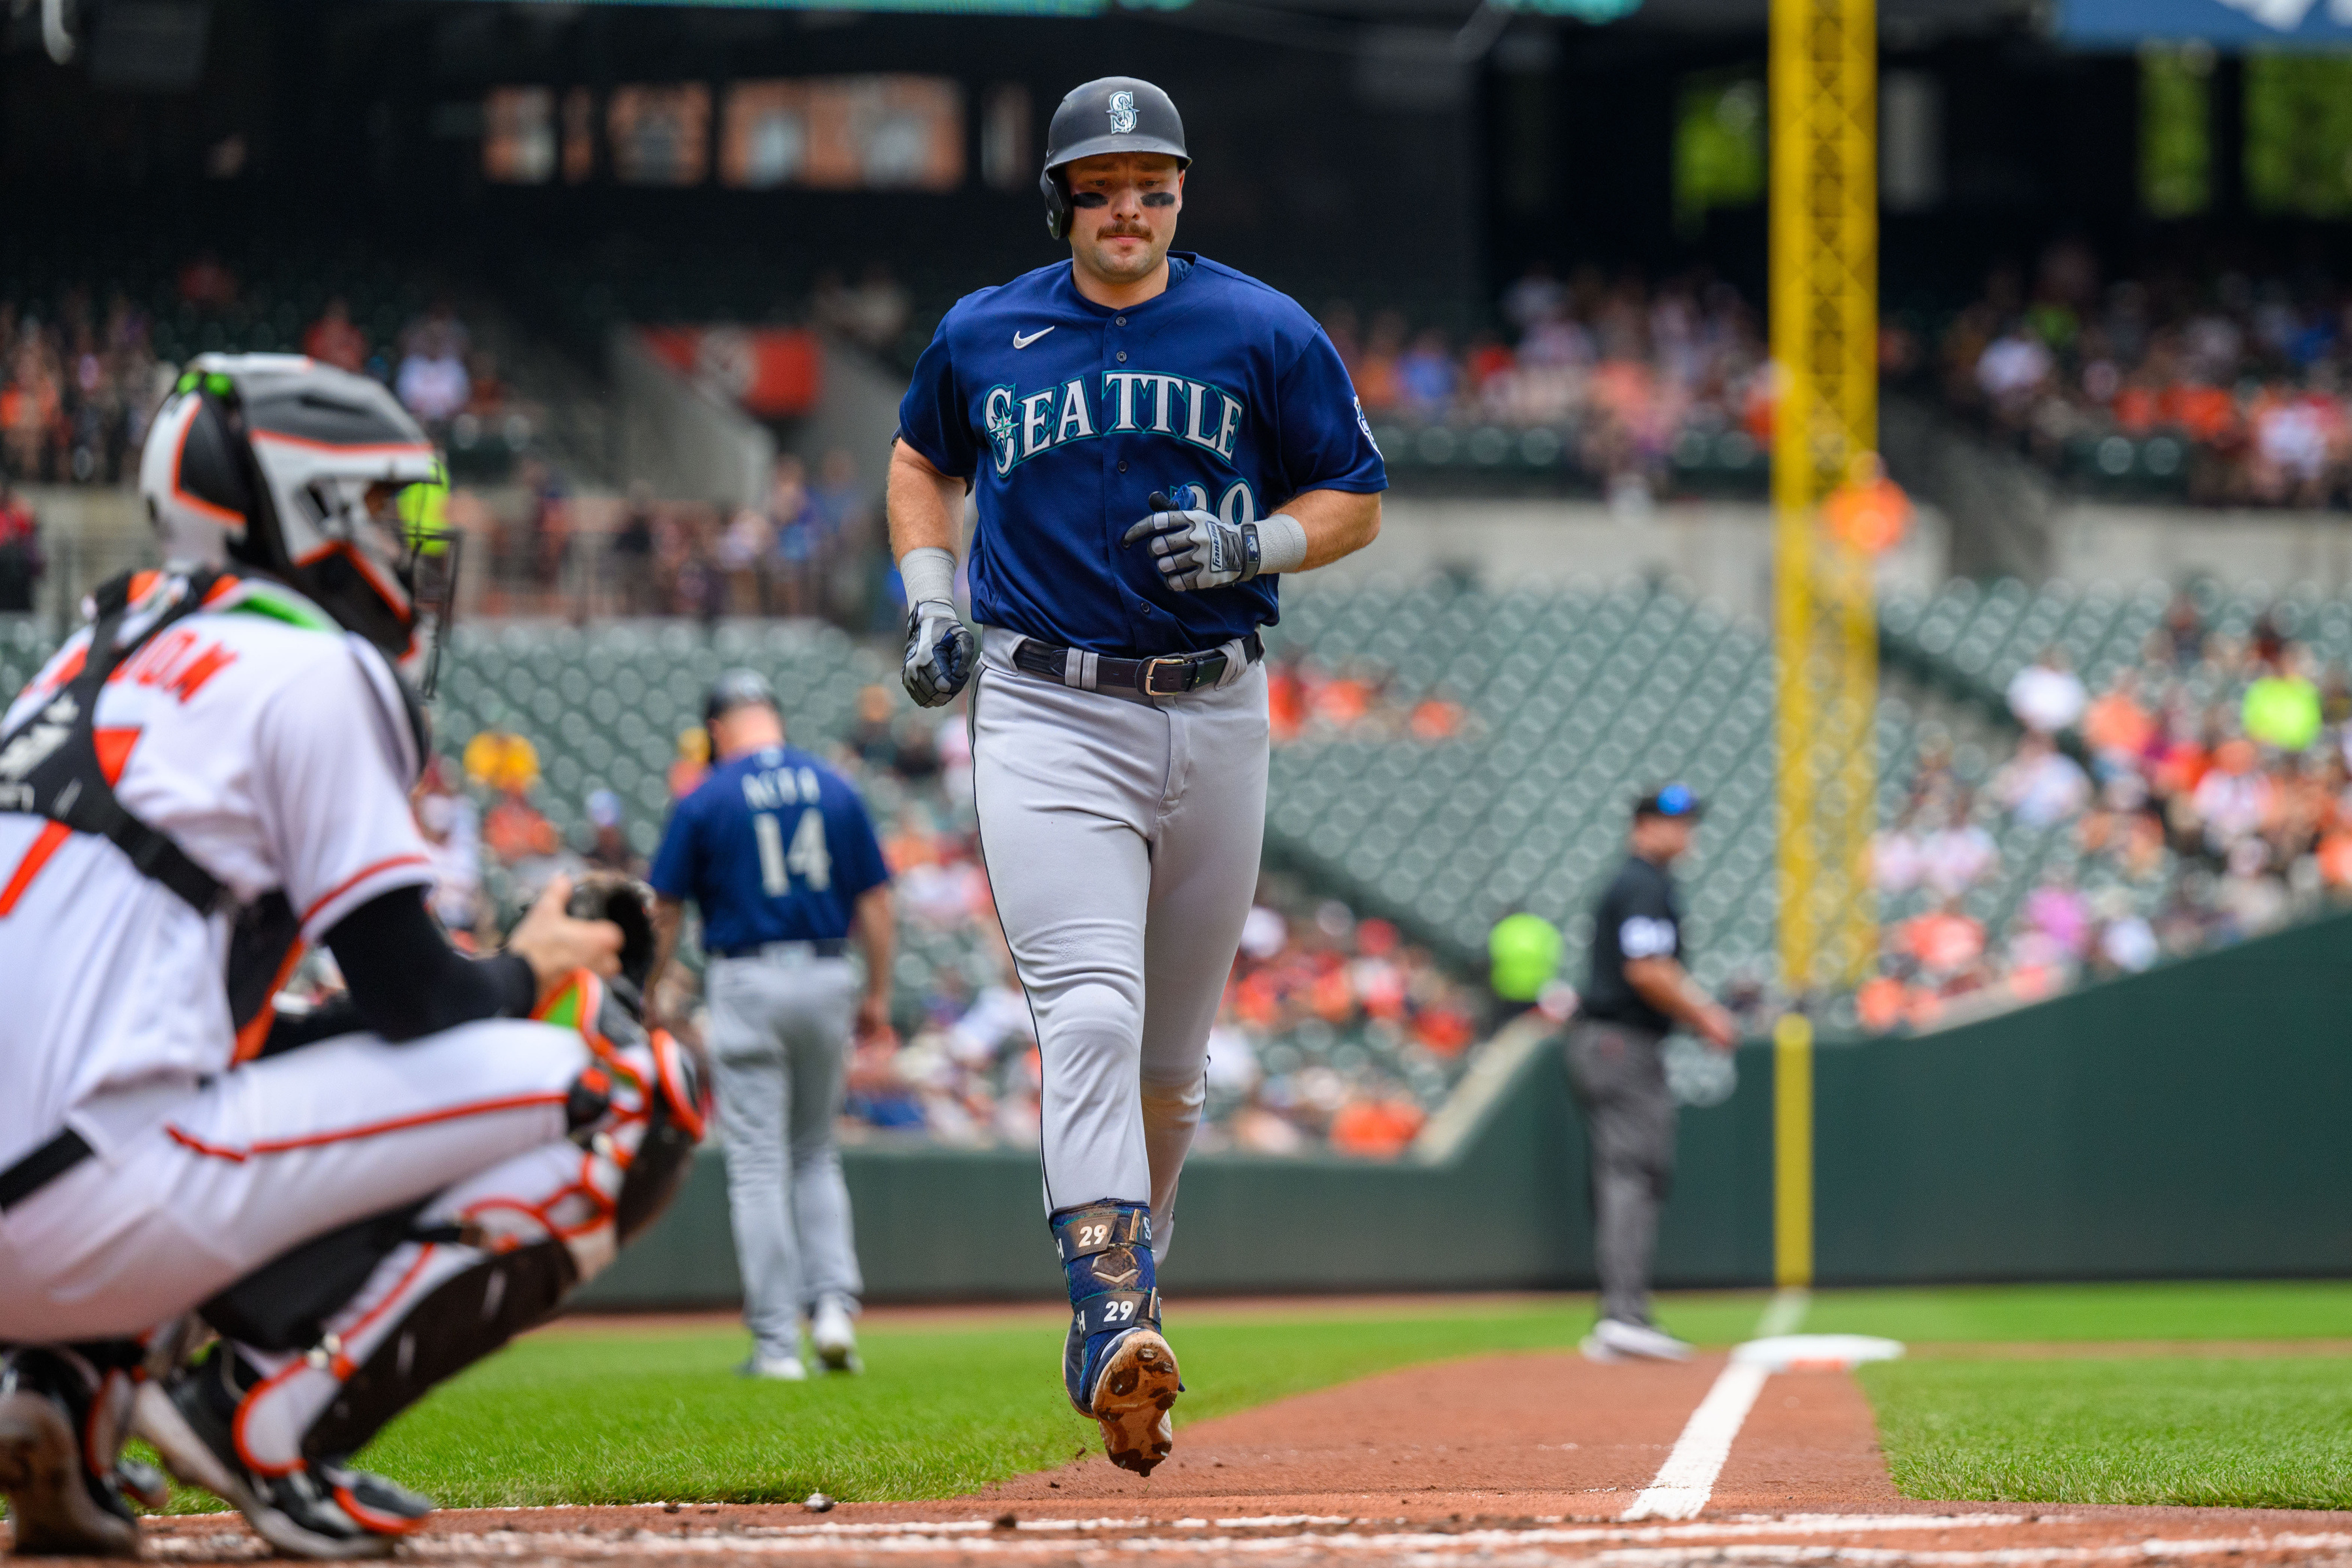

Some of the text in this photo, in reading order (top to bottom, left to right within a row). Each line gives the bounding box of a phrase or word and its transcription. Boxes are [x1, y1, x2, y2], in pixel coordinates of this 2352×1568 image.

[983, 369, 1244, 478] SEATTLE
[753, 806, 833, 898] 14
[1078, 1224, 1108, 1248] 29
[1103, 1300, 1134, 1322] 29
